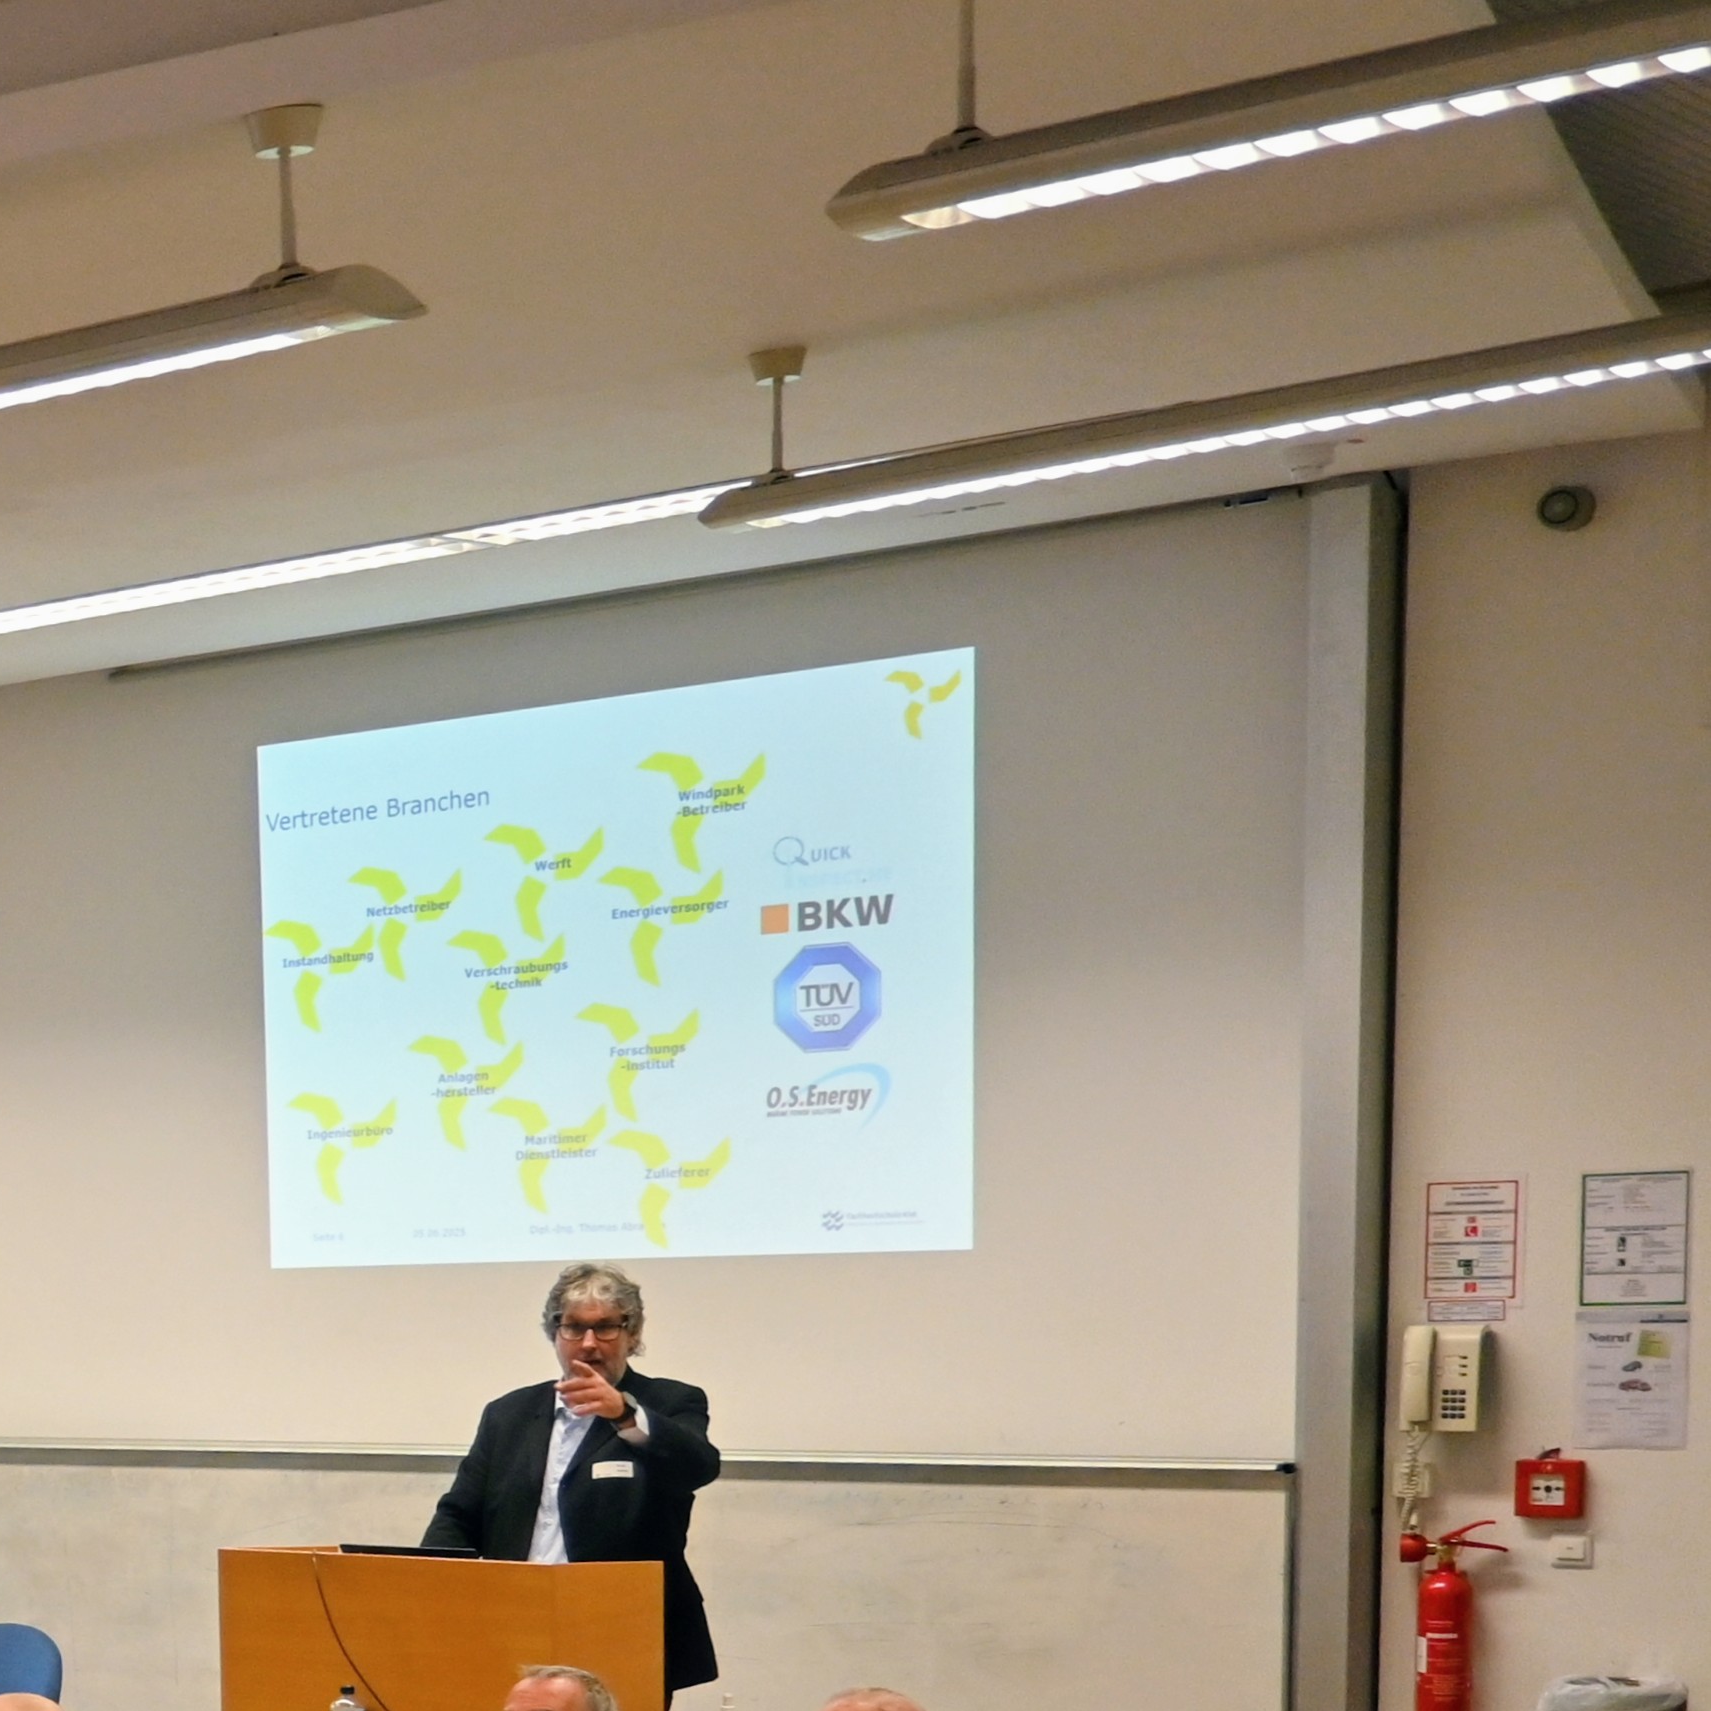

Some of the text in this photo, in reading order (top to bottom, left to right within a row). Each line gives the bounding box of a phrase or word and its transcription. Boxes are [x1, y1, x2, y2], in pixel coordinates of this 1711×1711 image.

[677, 784, 746, 802] Windpark
[265, 790, 491, 832] Vertretene Branchen
[676, 800, 747, 818] -Betreiber
[534, 857, 572, 872] Werft
[366, 900, 452, 918] Netzbetreiber
[611, 900, 730, 920] Energieversorger
[797, 893, 895, 932] BKW
[282, 951, 375, 969] Instandhaltung
[464, 960, 569, 979] Verschraubungs
[489, 978, 543, 991] -technik
[799, 982, 854, 1008] TÜV
[813, 1013, 841, 1028] SÜD
[609, 1043, 687, 1058] Forschungs
[438, 1071, 489, 1084] Anlagen
[431, 1084, 497, 1099] -hersteller
[766, 1084, 873, 1112] O.S.Energy
[307, 1124, 394, 1142] Ingenieurbüro
[524, 1133, 588, 1146] Maritimer
[515, 1147, 598, 1161] Dienstleister
[644, 1166, 712, 1180] Zulieferer
